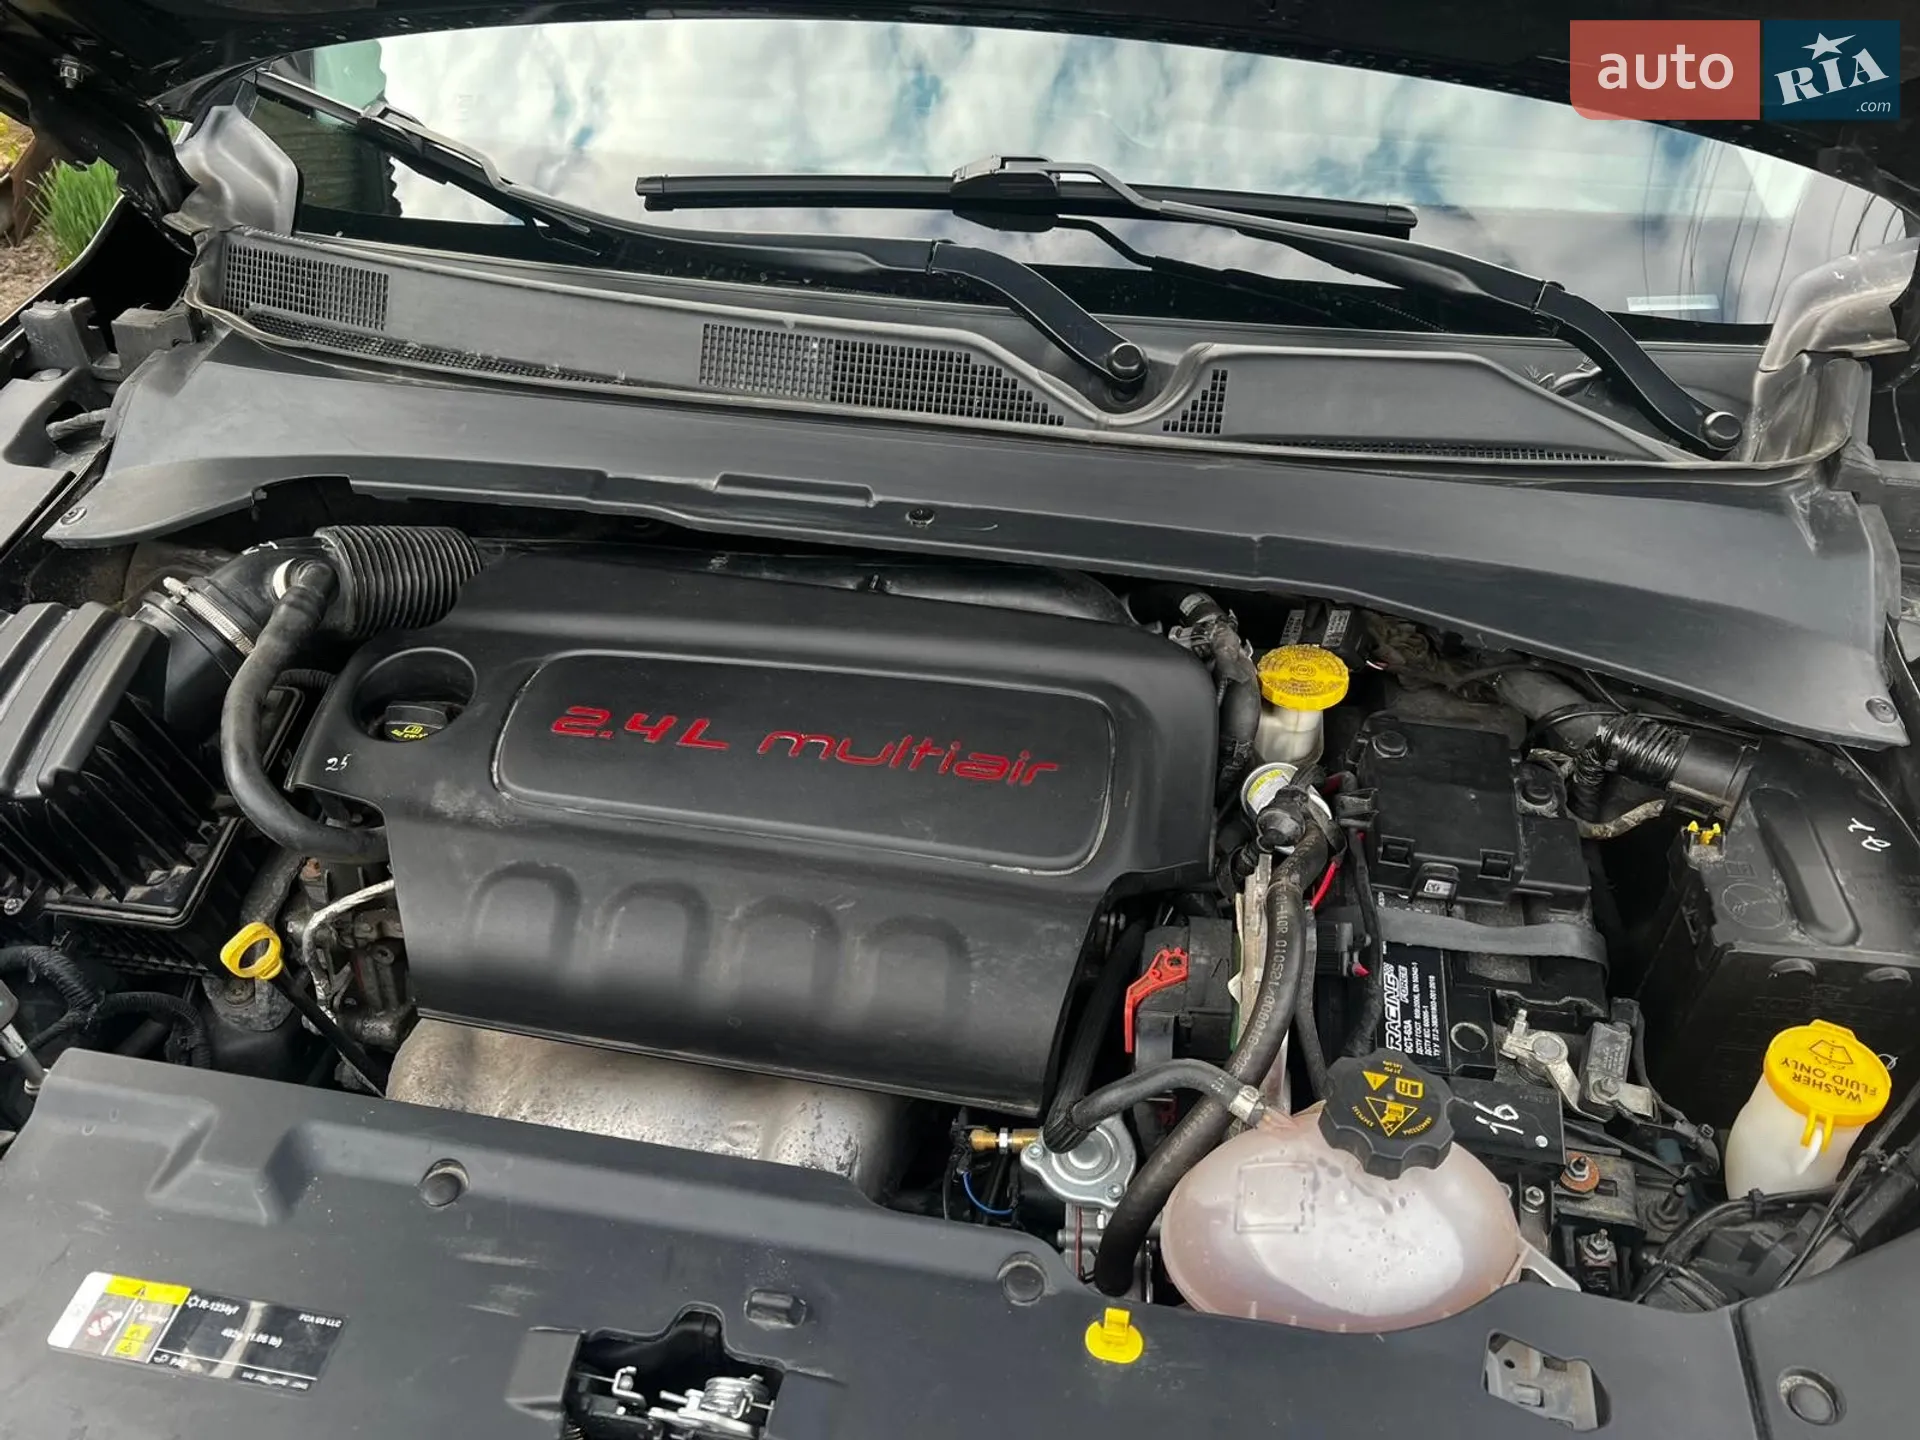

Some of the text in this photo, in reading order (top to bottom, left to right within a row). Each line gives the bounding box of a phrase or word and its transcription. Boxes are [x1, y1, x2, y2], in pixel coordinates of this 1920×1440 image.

[756, 733, 1059, 786] multiair
[1383, 972, 1403, 1052] RACING
[1780, 1056, 1878, 1097] FLUID ONLY
[1791, 1073, 1862, 1104] WASHER
